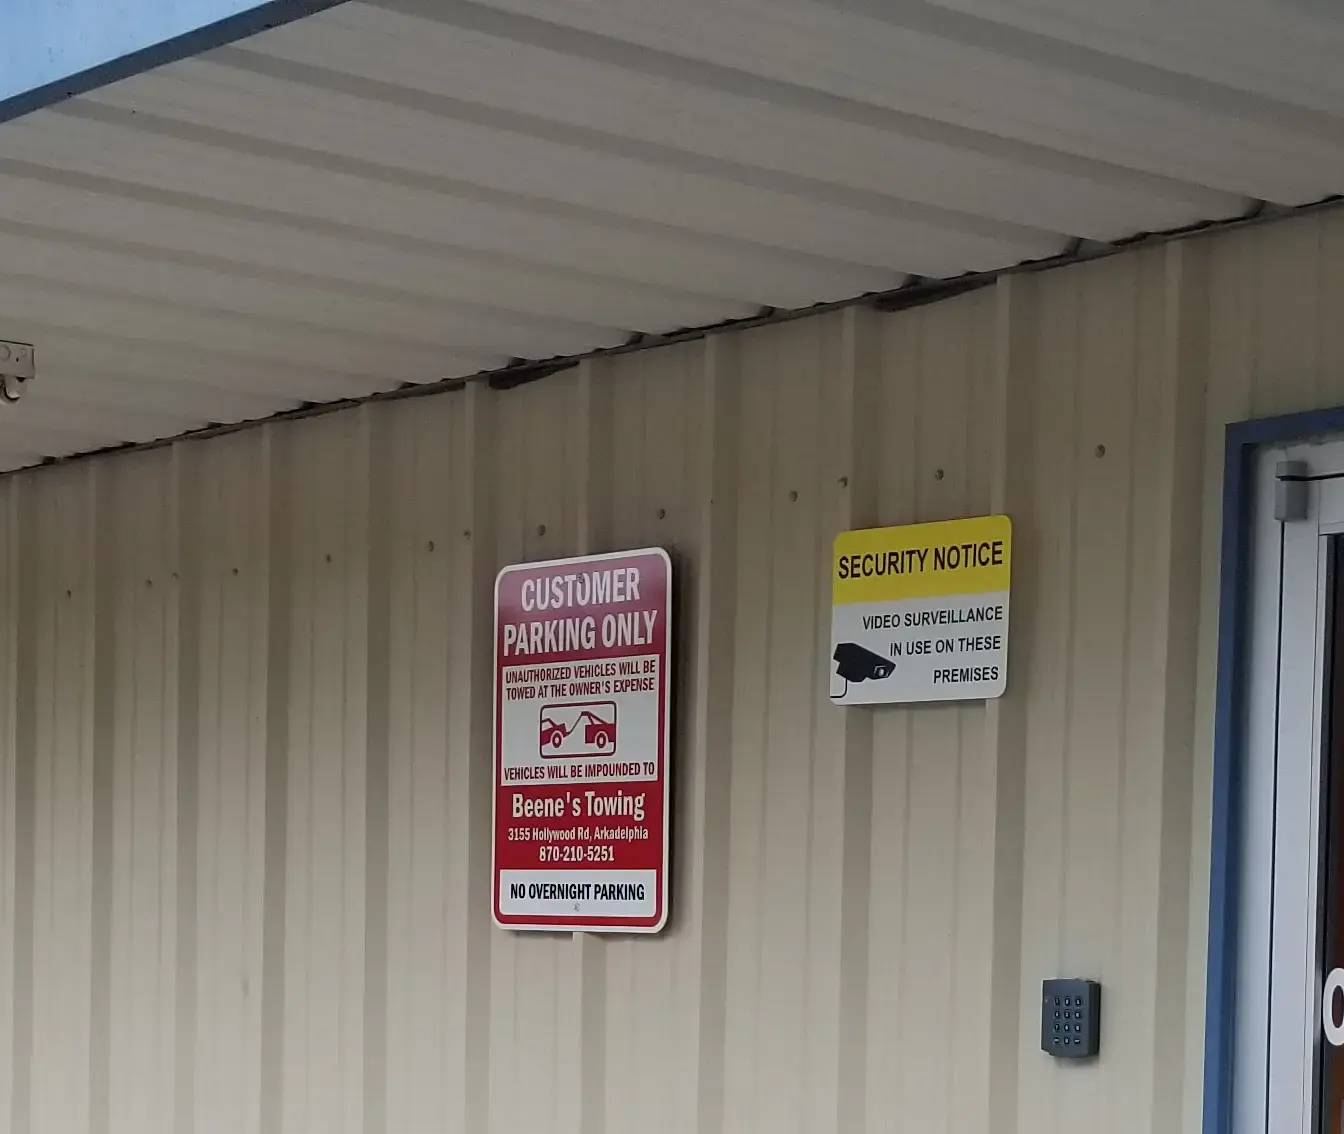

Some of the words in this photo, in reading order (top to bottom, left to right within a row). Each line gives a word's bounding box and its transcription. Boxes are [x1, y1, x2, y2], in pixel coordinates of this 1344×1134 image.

[838, 548, 929, 579] SECURITY
[934, 541, 1003, 571] NOTICE
[521, 567, 640, 612] CUSTOMER
[862, 613, 901, 630] VIDEO
[904, 605, 1003, 627] SURVEILLANCE
[503, 616, 596, 657] PARKING
[601, 609, 658, 648] ONLY
[890, 642, 902, 657] IN
[906, 640, 932, 655] USE
[935, 638, 954, 654] ON
[957, 635, 1001, 652] THESE
[506, 666, 571, 684] UNAUTHORIZED
[573, 663, 616, 679] VEHICLES
[618, 660, 640, 676] WILL
[643, 659, 656, 673] BE
[933, 666, 999, 684] PREMISES
[506, 686, 536, 701] TOWED
[538, 685, 548, 698] AT
[551, 683, 567, 697] THE
[569, 681, 611, 696] OWNER'S
[613, 677, 655, 693] EXPENSE
[504, 766, 545, 780] VEHICLES
[547, 765, 568, 779] WILL
[570, 765, 582, 778] BE
[585, 763, 640, 778] IMPOUNDED
[643, 762, 655, 775] TO
[512, 791, 581, 818] Beene's
[585, 790, 646, 821] Towing
[508, 828, 531, 841] 3155
[532, 827, 576, 844] Hollywood
[577, 827, 592, 842] Rd,
[594, 826, 648, 843] Arkadelphia
[539, 845, 615, 862] 870-210-5251
[510, 883, 526, 899] NO
[529, 883, 592, 900] OVERNIGHT
[594, 884, 645, 901] PARKING
